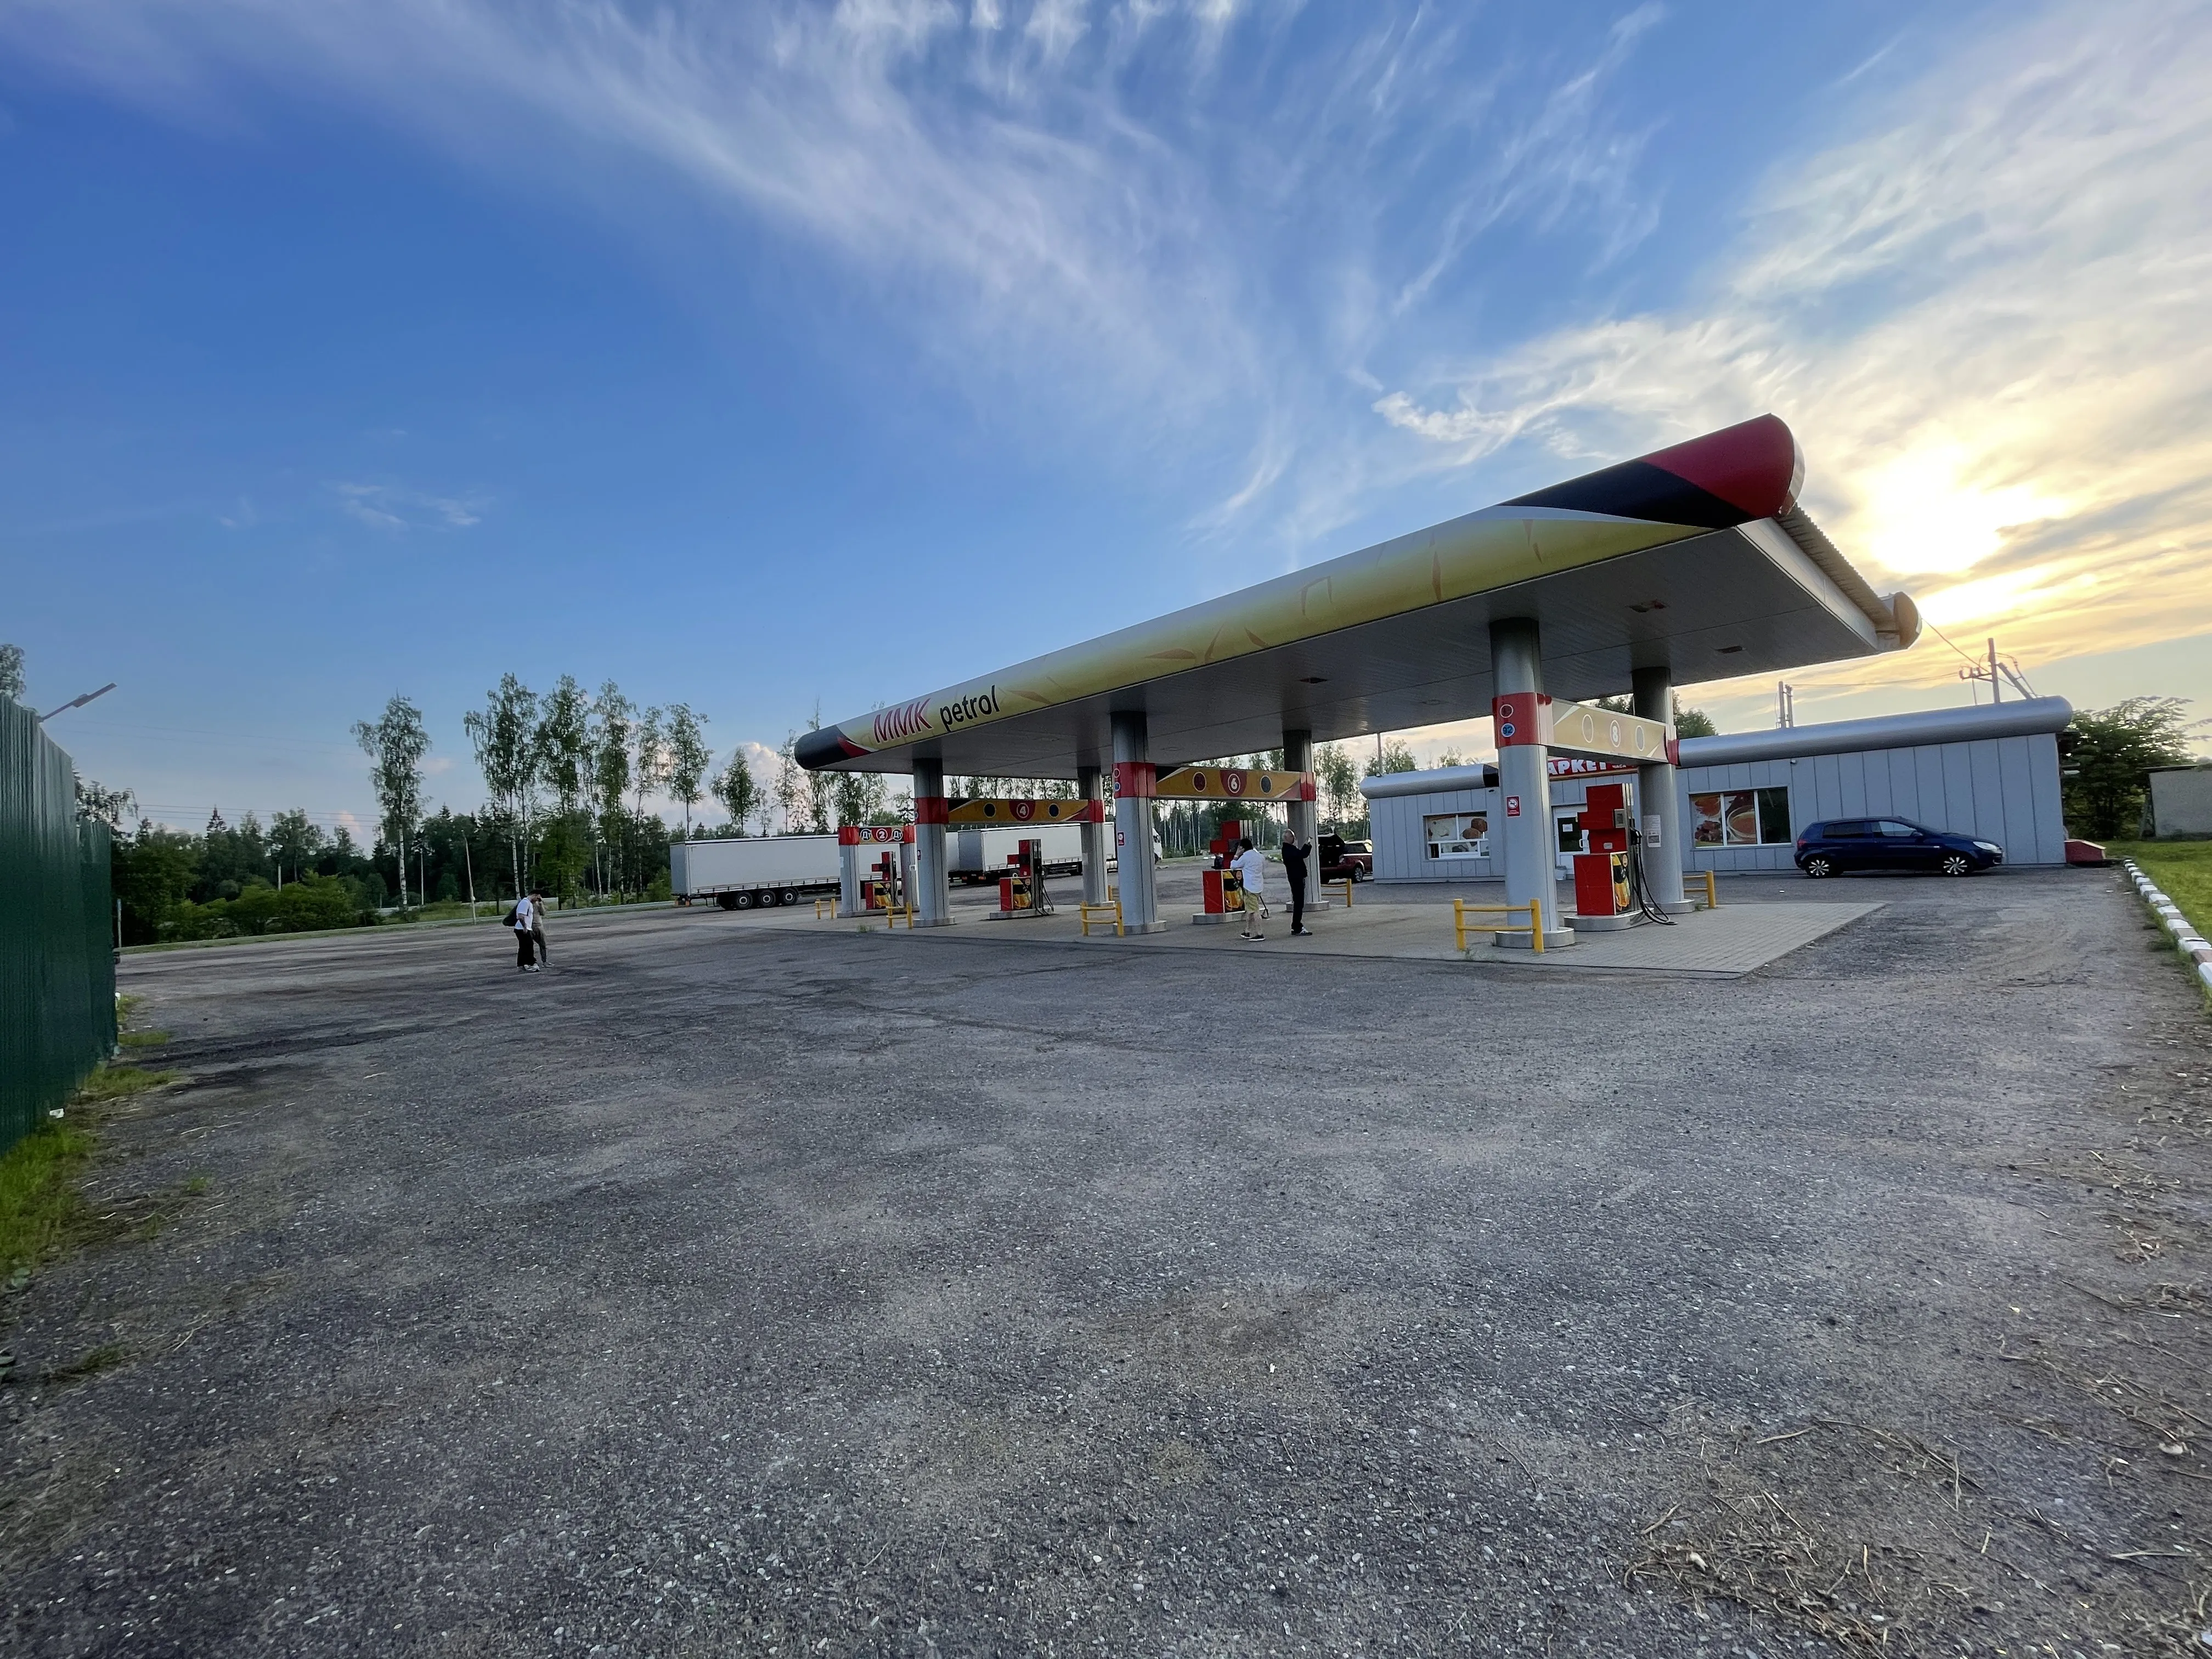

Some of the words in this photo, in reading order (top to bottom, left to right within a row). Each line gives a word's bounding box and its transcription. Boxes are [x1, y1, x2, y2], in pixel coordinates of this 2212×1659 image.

[873, 697, 932, 743] MMK
[940, 685, 1000, 732] petrol
[1502, 726, 1513, 735] 92
[1612, 725, 1618, 742] 8
[1231, 777, 1238, 790] 6
[1019, 806, 1026, 815] 4
[879, 831, 886, 839] 2
